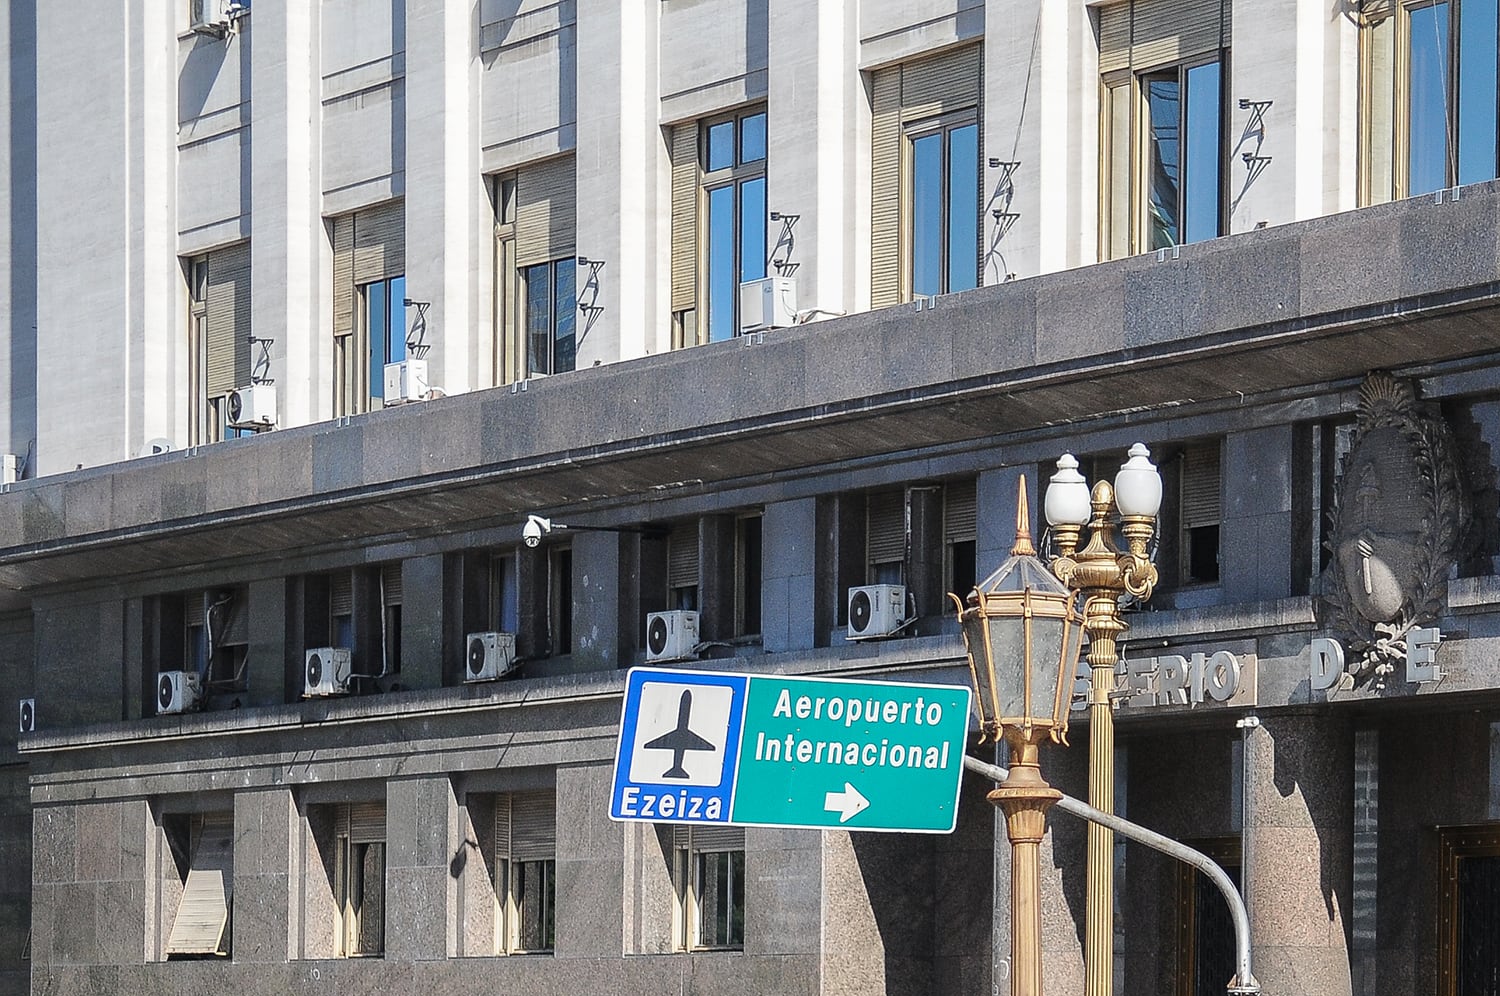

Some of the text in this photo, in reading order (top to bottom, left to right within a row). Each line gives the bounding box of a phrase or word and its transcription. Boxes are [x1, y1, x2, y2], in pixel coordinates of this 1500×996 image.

[772, 688, 943, 727] Aeropuerto
[754, 731, 950, 770] Internacional
[620, 786, 723, 820] Ezeiza
